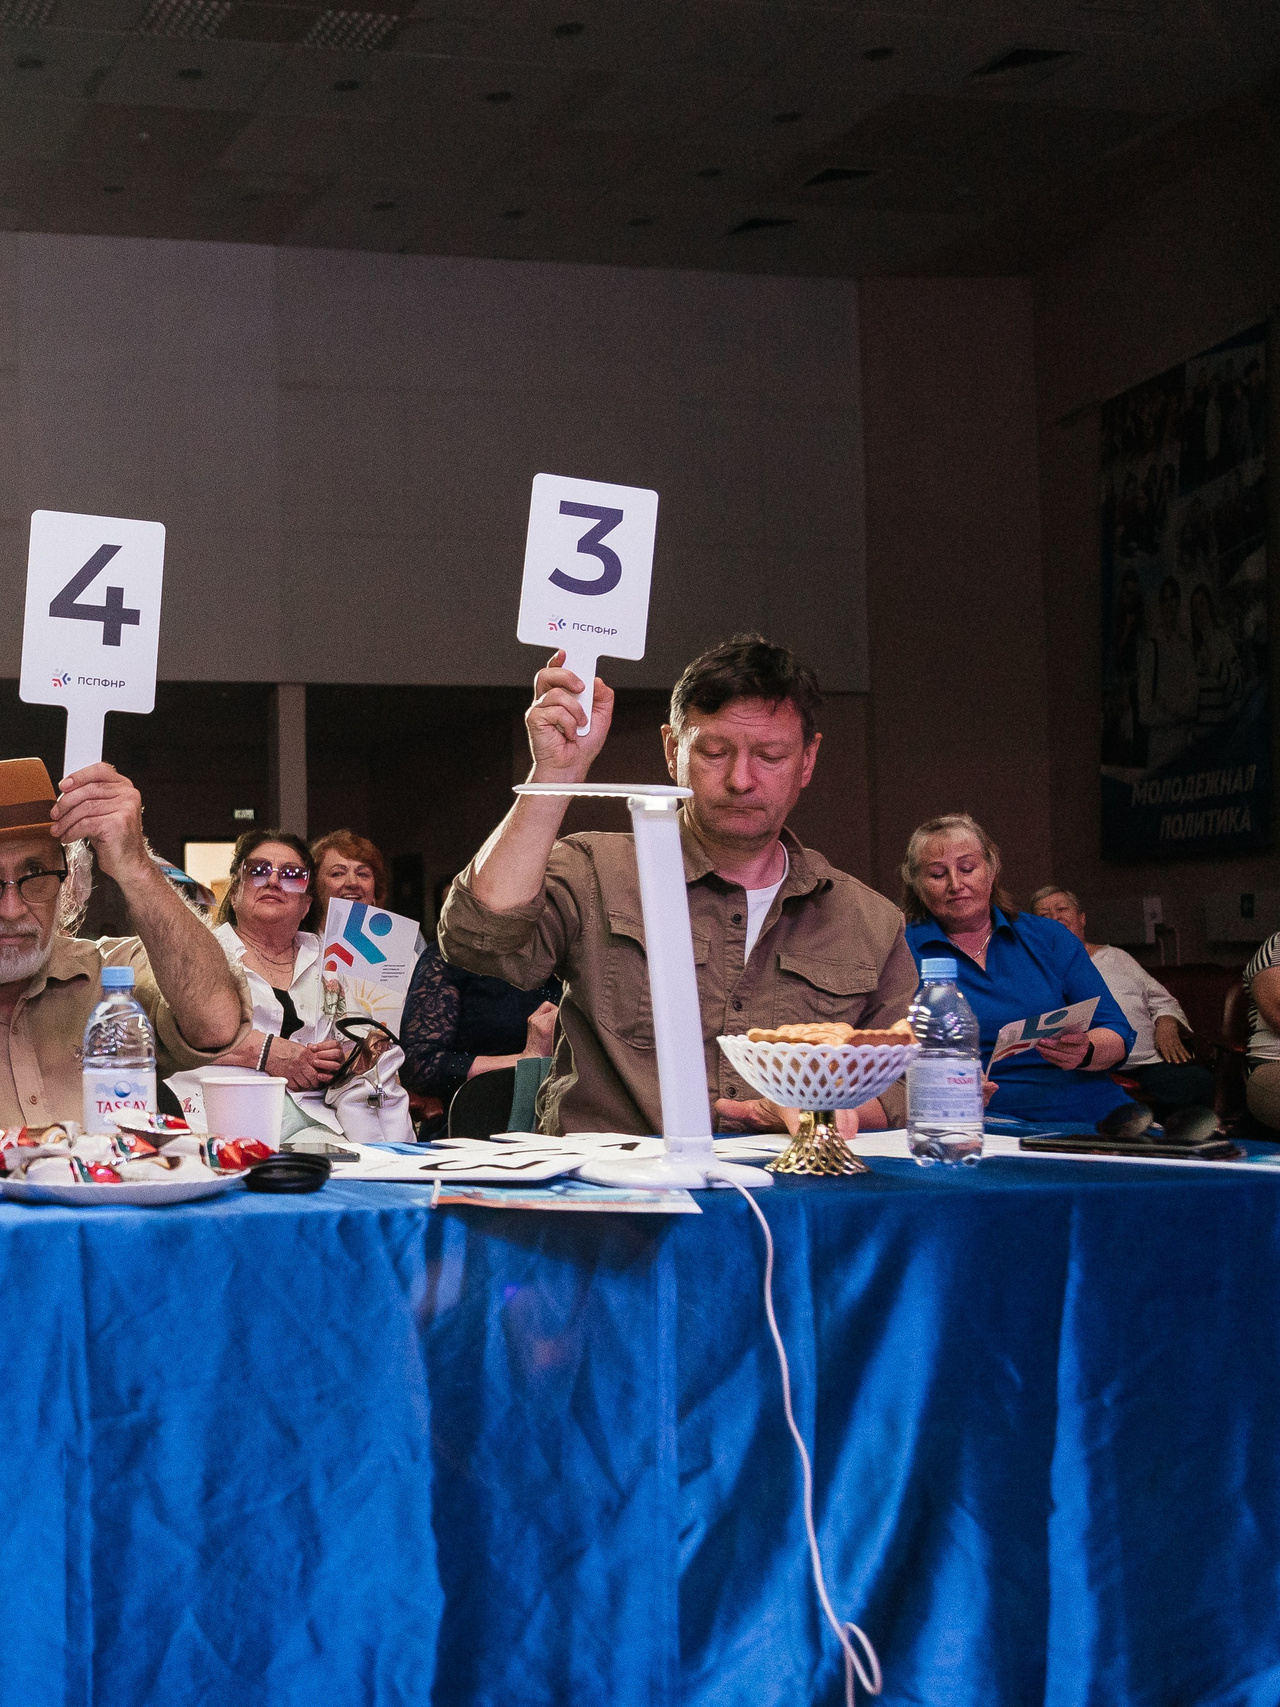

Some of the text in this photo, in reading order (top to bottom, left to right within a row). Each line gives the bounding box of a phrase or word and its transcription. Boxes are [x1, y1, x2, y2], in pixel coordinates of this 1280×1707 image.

[548, 500, 624, 596] 3
[48, 543, 141, 647] 4
[571, 622, 618, 636] ПСПФНР
[77, 676, 126, 689] ПСПФНР
